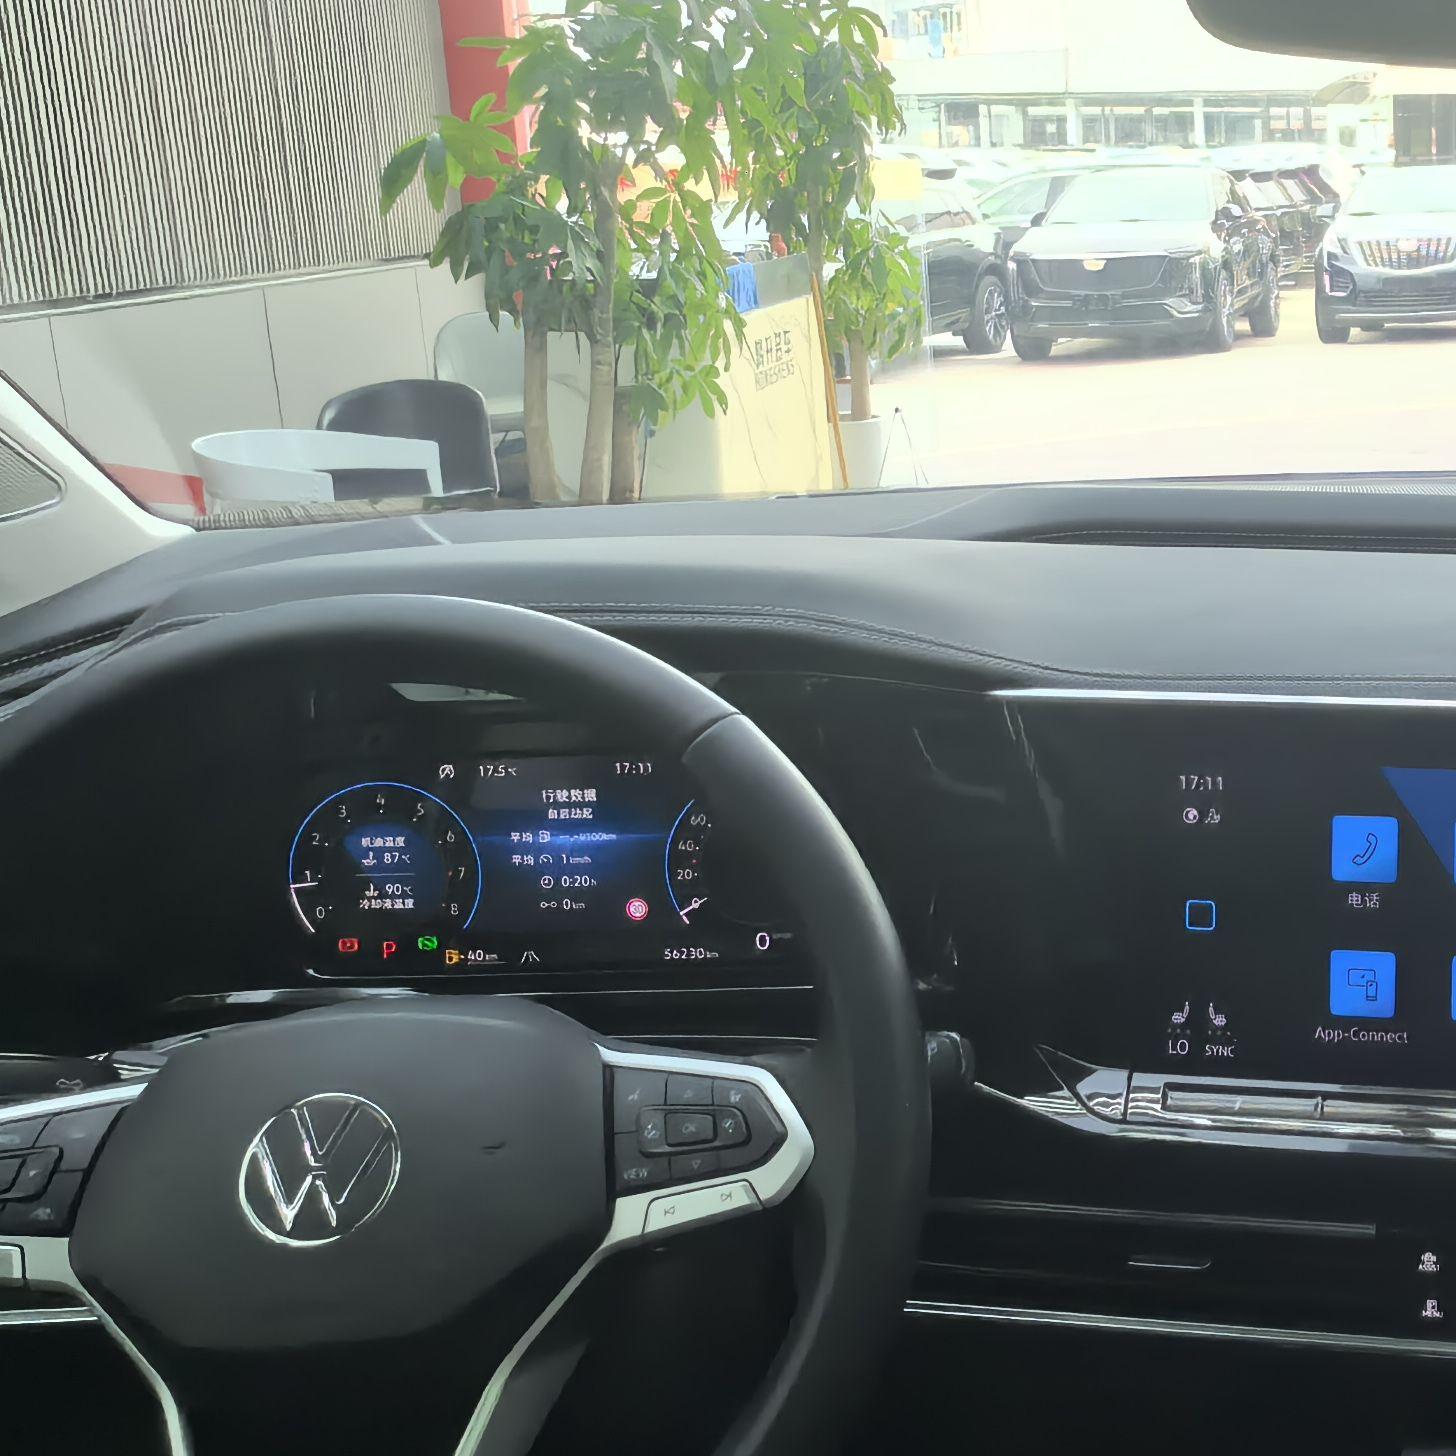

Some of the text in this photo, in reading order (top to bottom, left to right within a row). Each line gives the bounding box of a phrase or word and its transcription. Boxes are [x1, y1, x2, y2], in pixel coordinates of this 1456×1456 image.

[615, 762, 652, 774] 17:11
[1179, 775, 1223, 790] 17:11
[338, 805, 347, 818] 3
[416, 802, 425, 816] 5
[690, 813, 706, 826] 60
[311, 832, 320, 845] 2
[446, 830, 455, 842] 6
[510, 831, 533, 843] 平均
[678, 840, 694, 851] 40
[512, 854, 534, 866] 平均
[457, 867, 465, 880] 7
[677, 868, 693, 880] 20
[1347, 891, 1380, 909] 电话
[316, 906, 325, 919] 0
[450, 903, 459, 915] 8
[755, 932, 770, 950] 0
[1314, 1026, 1408, 1044] App-Connect
[1168, 1039, 1189, 1055] LO
[1205, 1044, 1236, 1057] SYNC
[1421, 1310, 1444, 1318] MENU
